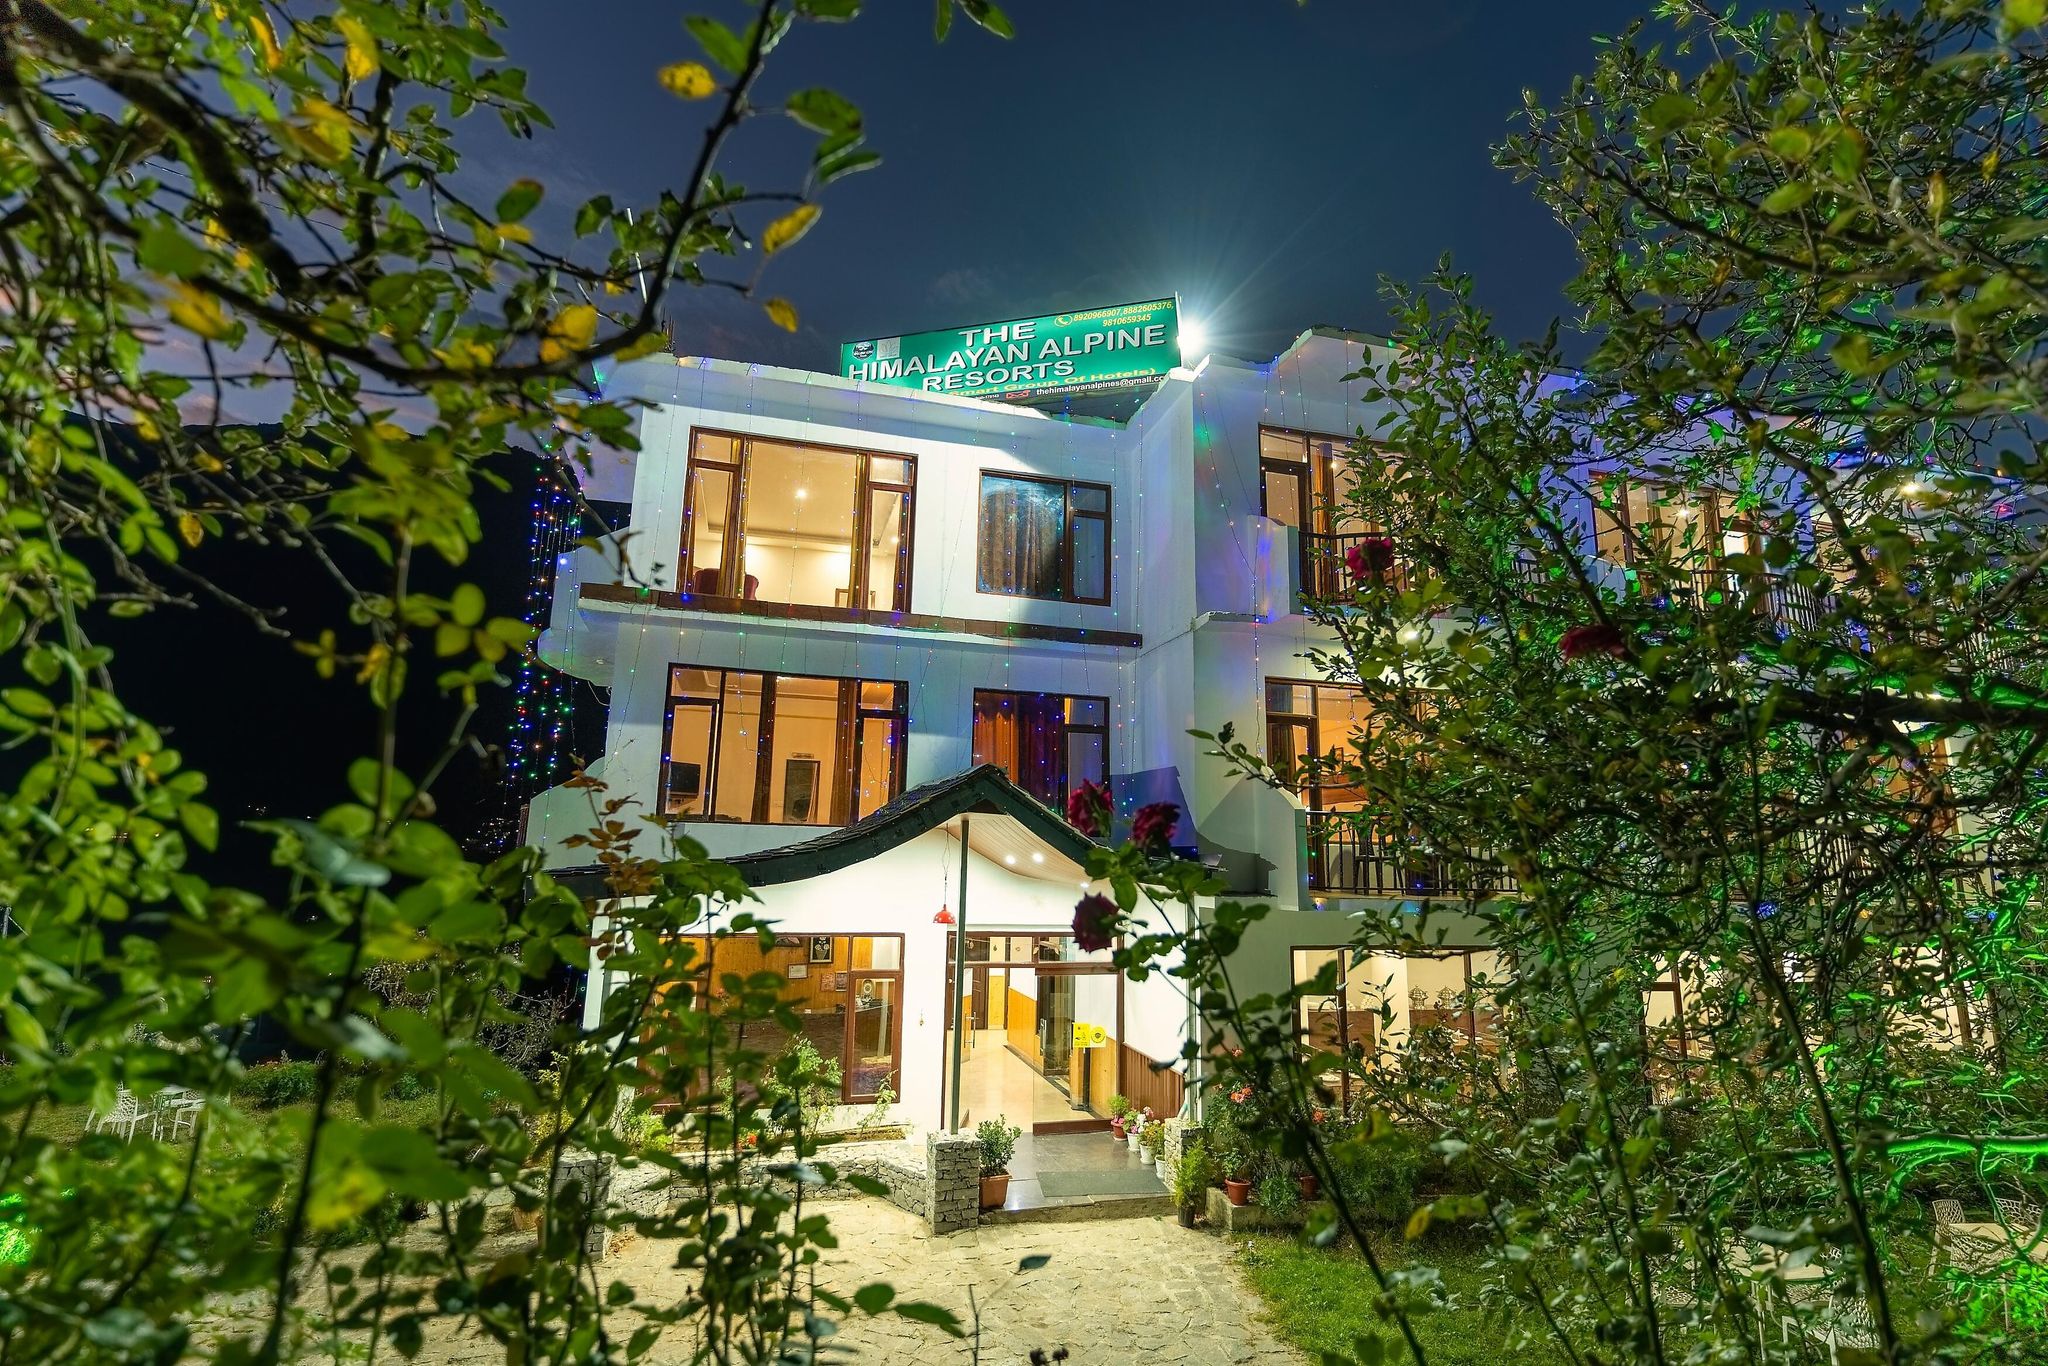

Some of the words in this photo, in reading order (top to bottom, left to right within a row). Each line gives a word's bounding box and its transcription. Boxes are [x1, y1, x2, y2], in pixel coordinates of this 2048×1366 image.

[1102, 313, 1152, 328] 9810659345
[958, 322, 1036, 347] THE
[848, 341, 1030, 381] HIMALAYAN
[1038, 324, 1166, 360] ALPINE
[922, 360, 1075, 392] RESORTS
[1004, 380, 1058, 391] Group
[1064, 375, 1087, 385] Of
[1087, 368, 1156, 382] Hotels)
[1036, 375, 1164, 395] thehimalayanalpines@gmail.co
